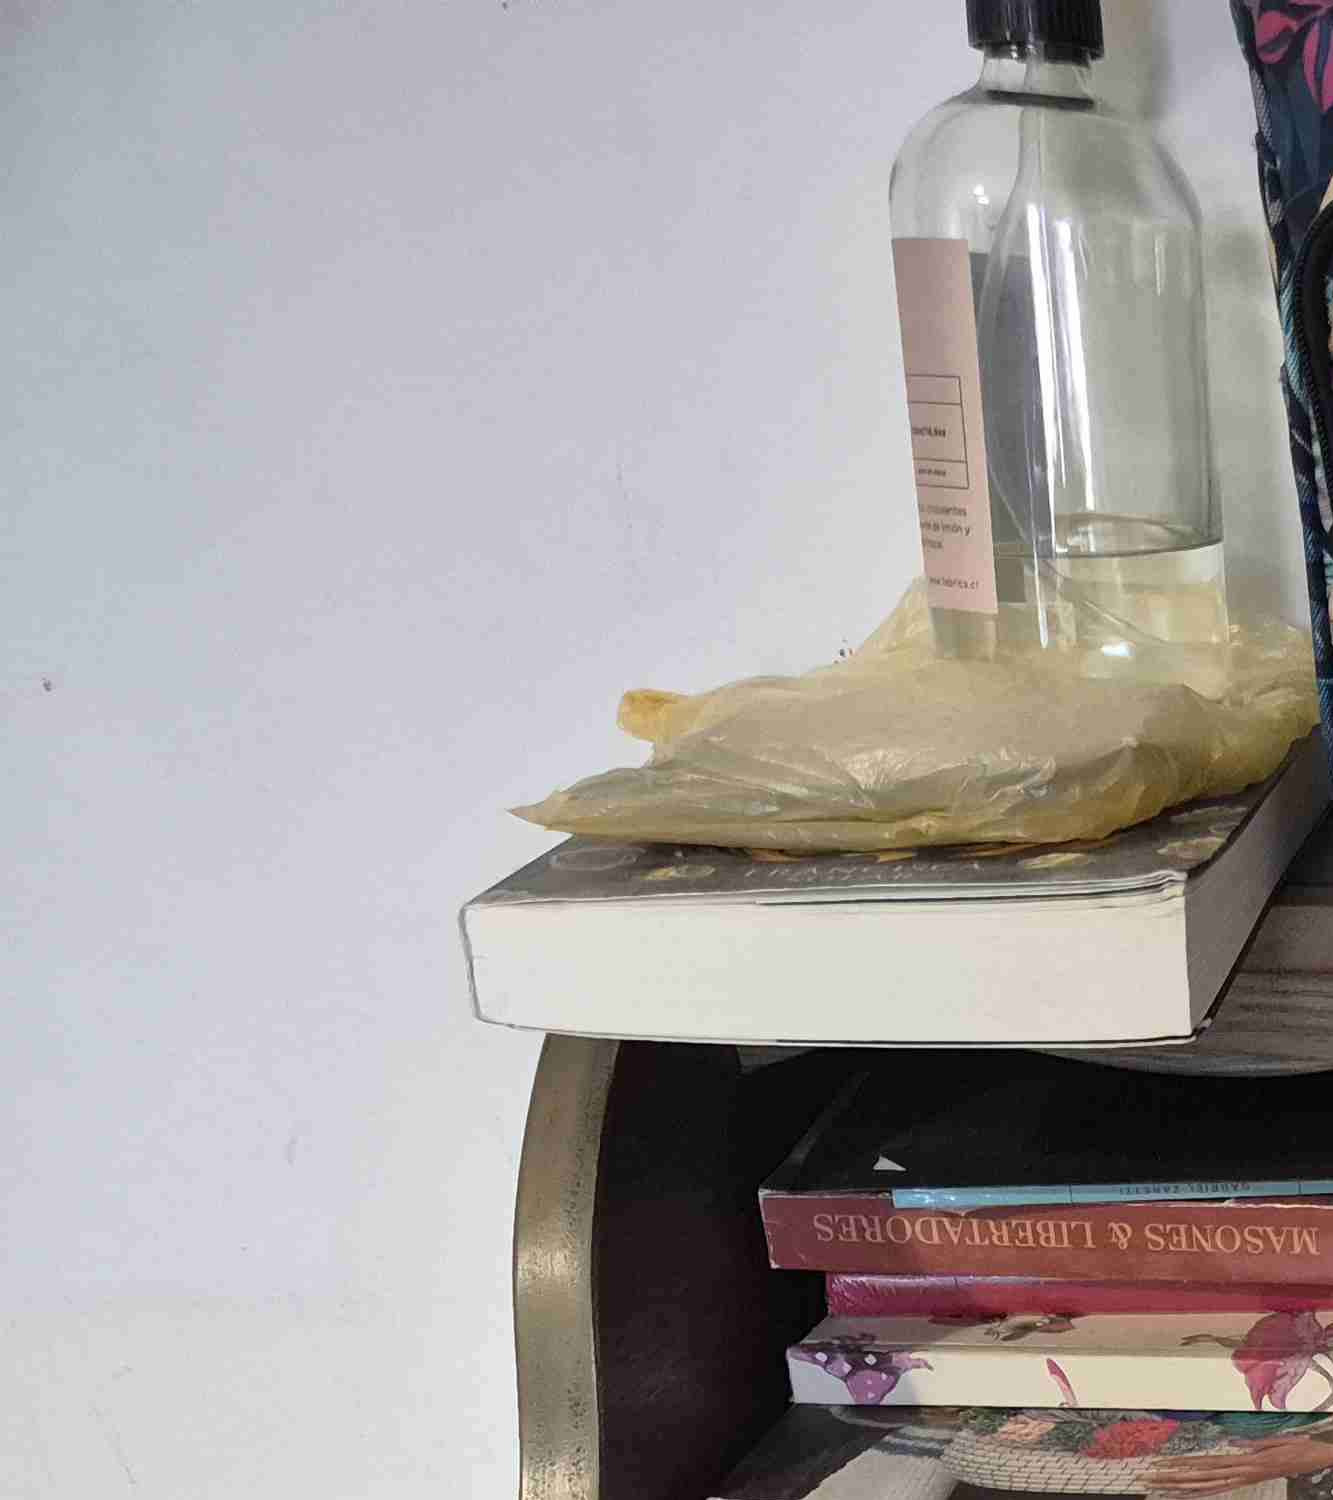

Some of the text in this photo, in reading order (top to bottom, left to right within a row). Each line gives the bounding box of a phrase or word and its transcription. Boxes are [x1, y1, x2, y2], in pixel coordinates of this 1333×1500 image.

[812, 1212, 1097, 1250] LIBERTADORES
[1107, 1221, 1132, 1251] &
[1146, 1223, 1321, 1256] MASONES
